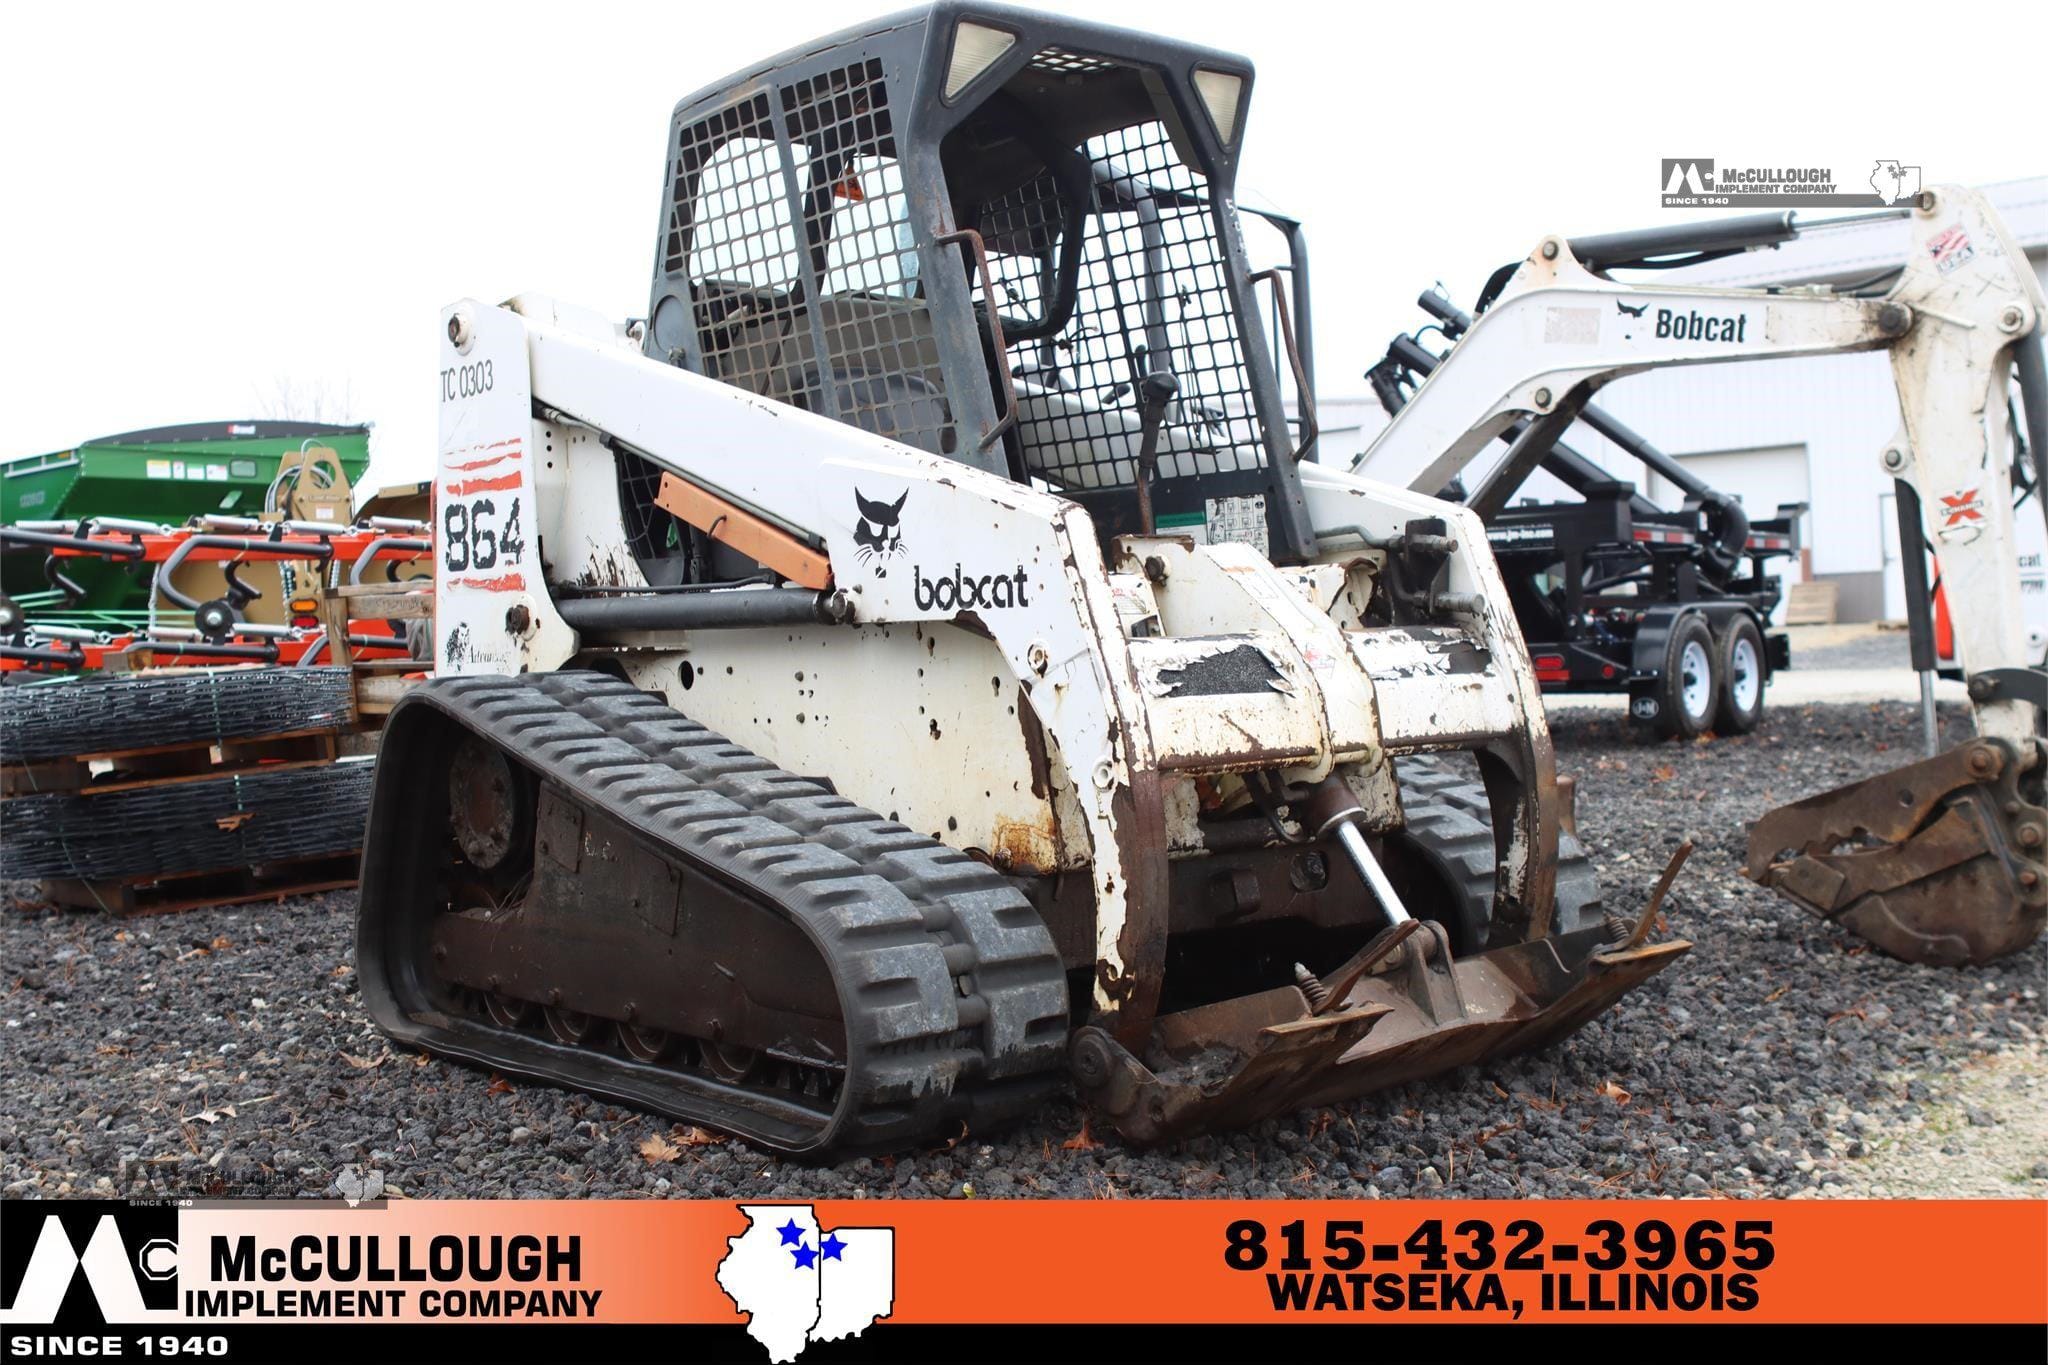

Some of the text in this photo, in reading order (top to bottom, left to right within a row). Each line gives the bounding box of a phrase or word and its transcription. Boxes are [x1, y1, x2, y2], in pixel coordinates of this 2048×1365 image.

[1655, 308, 1746, 343] Bobcat
[440, 359, 494, 402] TC 0303
[445, 497, 525, 572] 864
[913, 562, 1029, 612] bobcat
